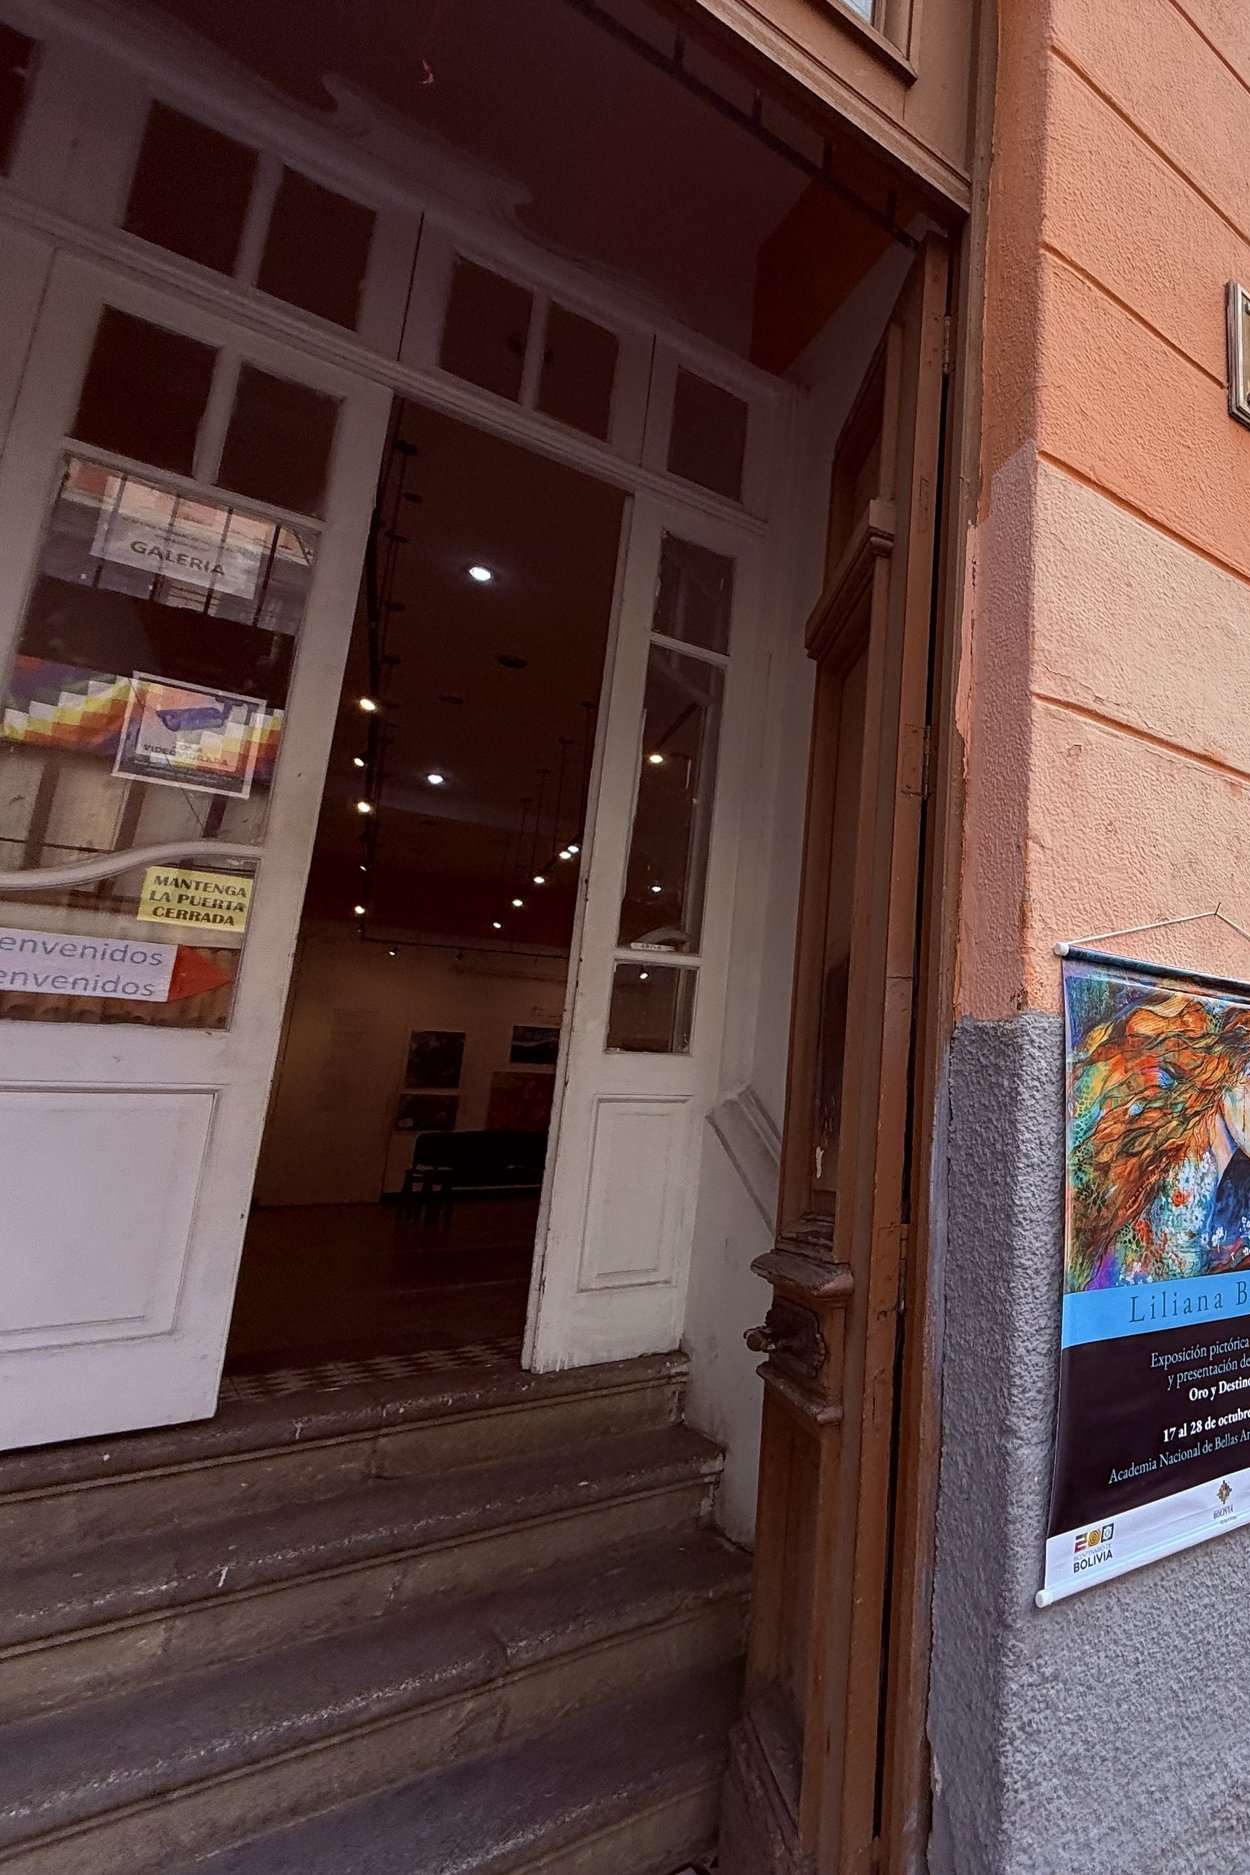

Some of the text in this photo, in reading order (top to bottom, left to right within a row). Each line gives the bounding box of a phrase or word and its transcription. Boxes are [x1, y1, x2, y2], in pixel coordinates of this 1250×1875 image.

[130, 540, 225, 576] GALERIA
[154, 875, 247, 898] MANTENGA
[149, 890, 247, 913] LA PUERTA
[152, 906, 235, 927] CERRADA
[1129, 1290, 1224, 1323] Liliana
[1150, 1344, 1208, 1370] Exposición
[1209, 1337, 1250, 1360] pictórica
[1167, 1375, 1175, 1391] y
[1177, 1358, 1238, 1389] presentación
[1240, 1353, 1250, 1368] de
[1188, 1387, 1209, 1401] Oro
[1210, 1386, 1217, 1401] y
[1163, 1427, 1177, 1443] 17
[1178, 1423, 1187, 1438] al
[1190, 1419, 1203, 1435] 28
[1204, 1416, 1216, 1431] de
[1108, 1458, 1158, 1484] Academia
[1159, 1442, 1201, 1468] Nacional
[1202, 1440, 1213, 1454] de
[1214, 1433, 1239, 1451] Bellas
[1073, 1549, 1113, 1573] BOLIVIA
